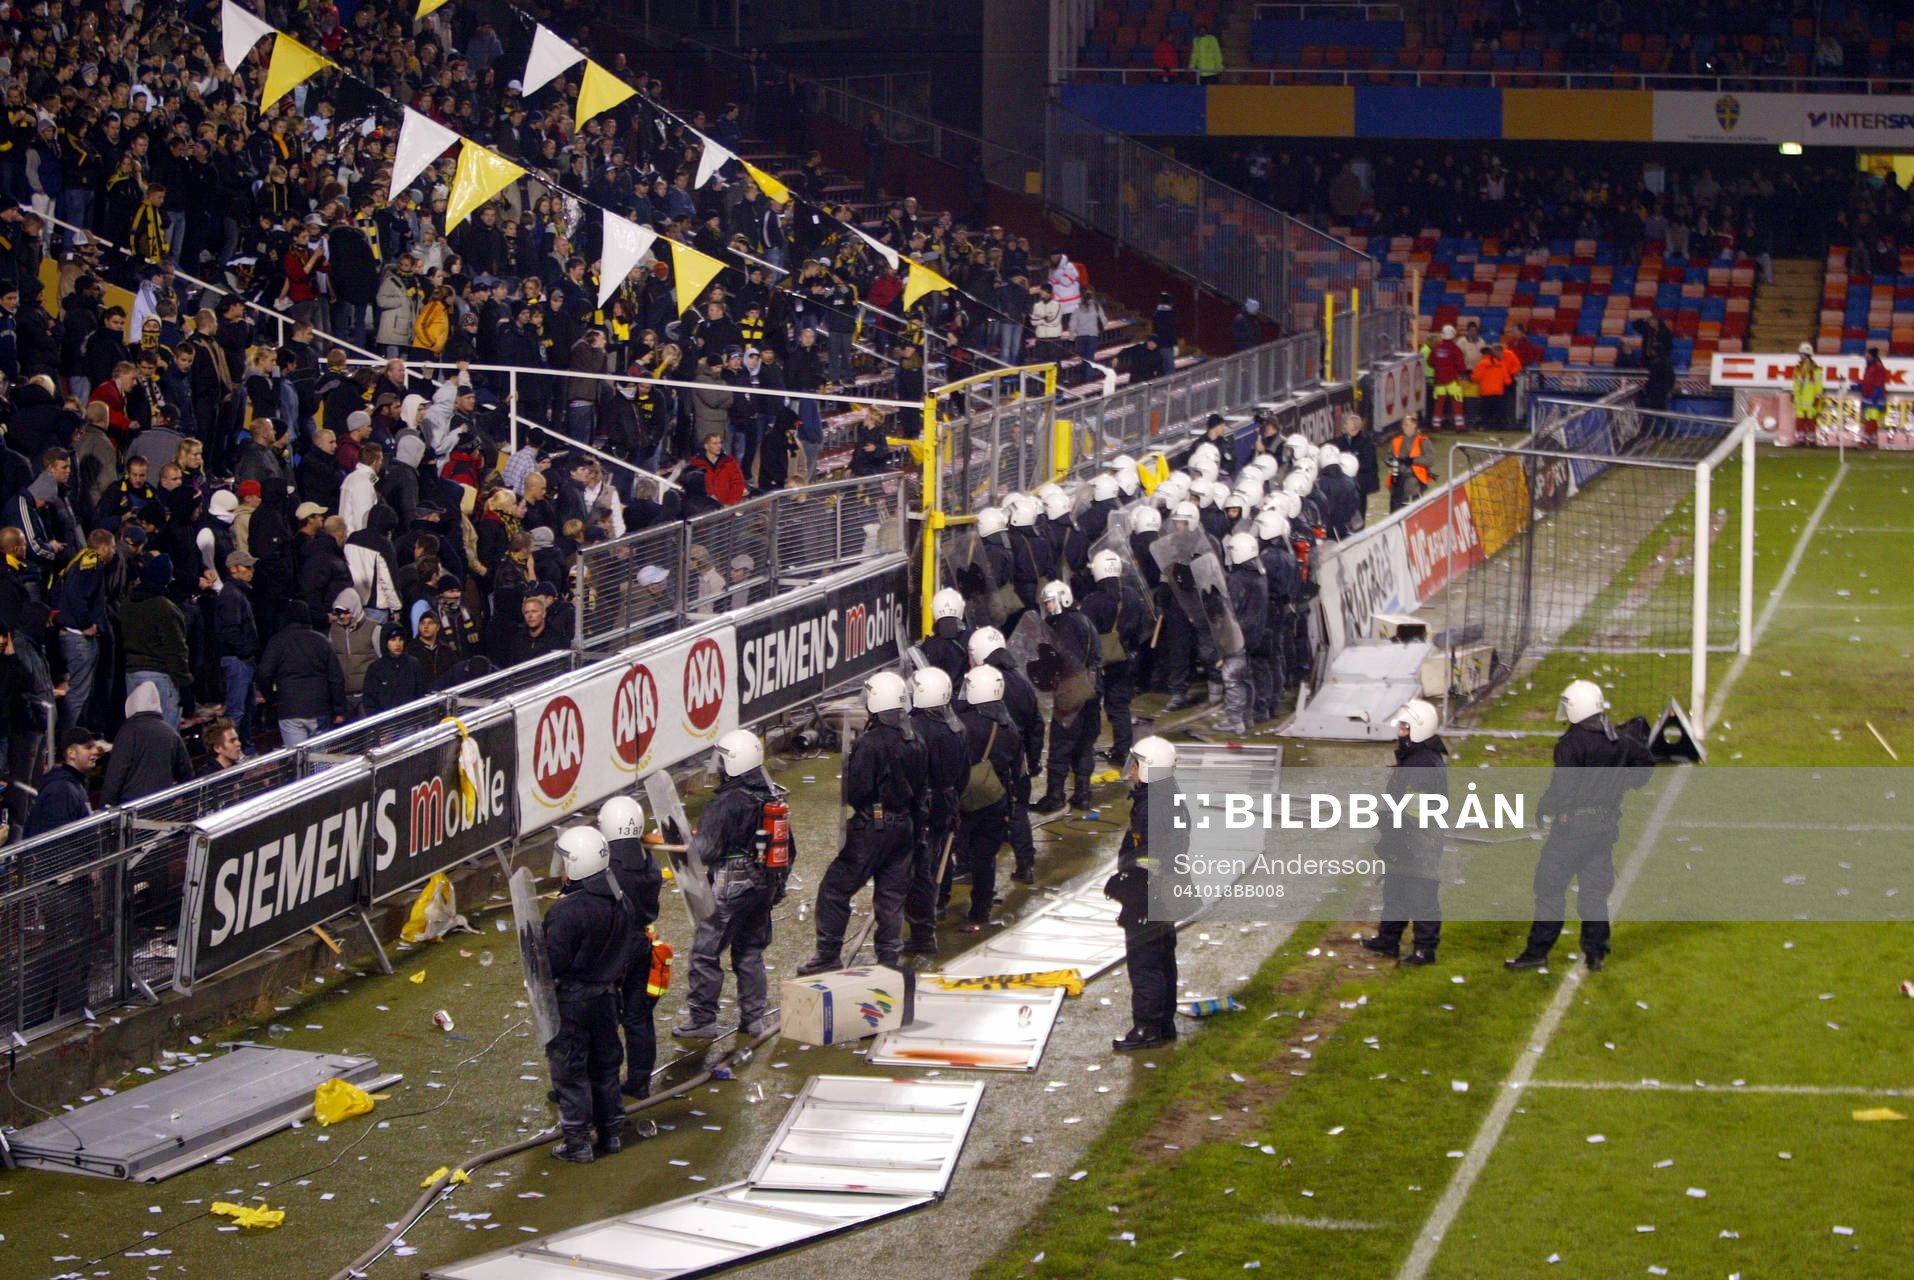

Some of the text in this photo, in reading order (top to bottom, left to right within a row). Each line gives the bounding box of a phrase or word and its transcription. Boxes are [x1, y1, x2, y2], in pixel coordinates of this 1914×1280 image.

[1829, 112, 1914, 129] INTERSP
[688, 646, 723, 712] AXA
[742, 592, 903, 704] SIEMENS mobile
[538, 706, 581, 781] AXA
[617, 672, 656, 747] AXA
[209, 756, 505, 947] SIEMENS mole
[628, 817, 635, 826] A
